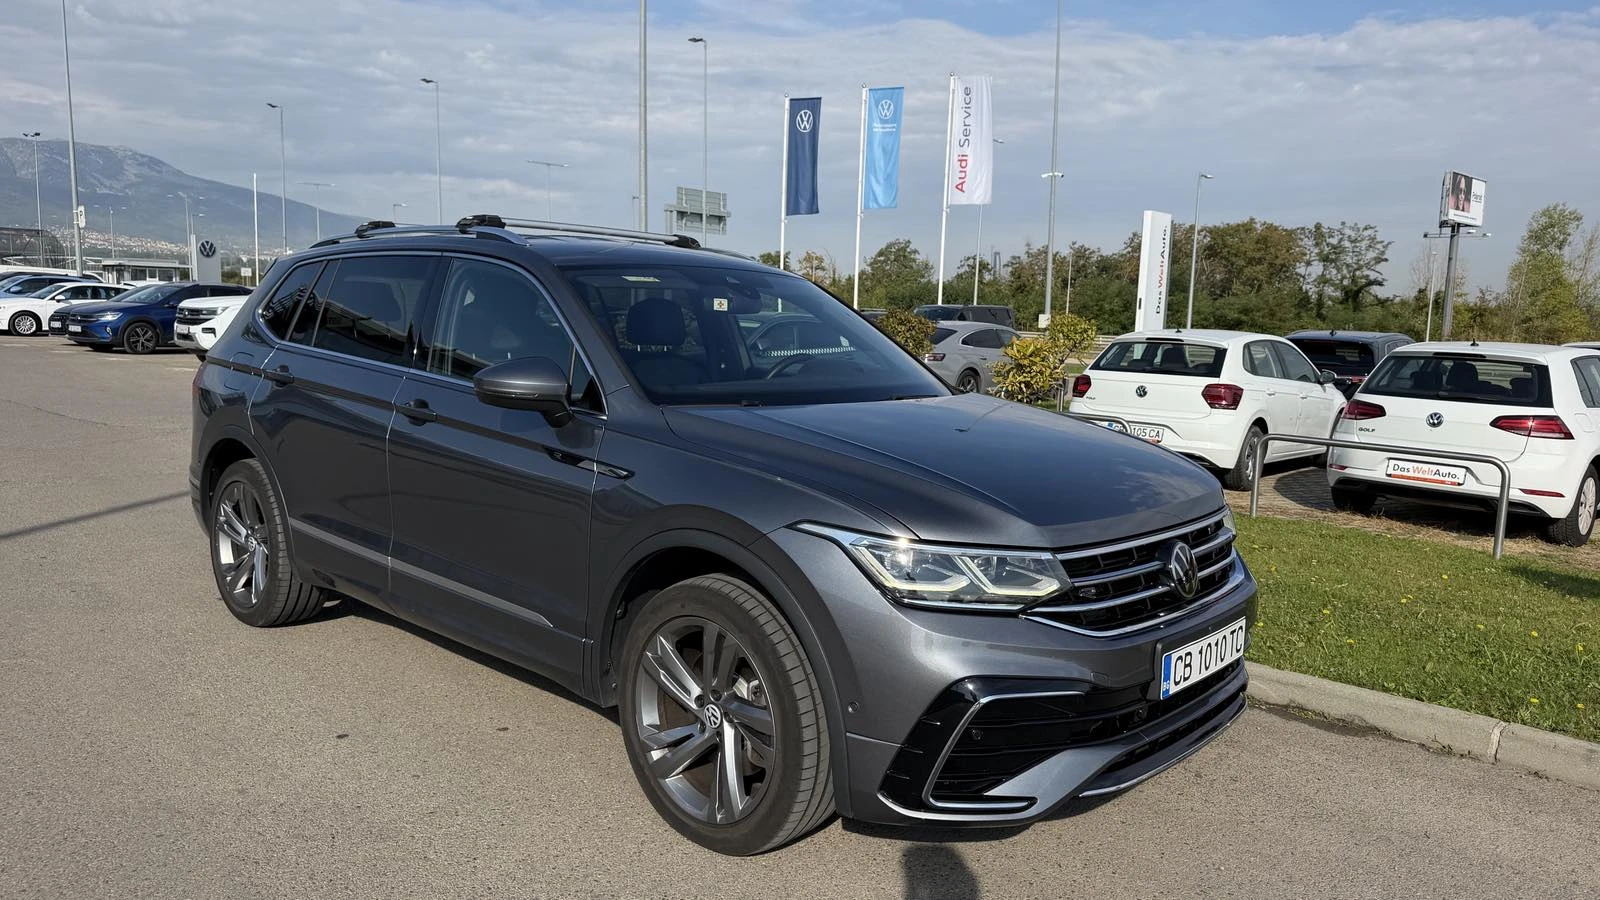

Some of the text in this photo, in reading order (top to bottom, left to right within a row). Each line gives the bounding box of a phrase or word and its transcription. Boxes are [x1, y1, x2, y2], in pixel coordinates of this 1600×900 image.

[955, 86, 972, 193] Audi Service
[1148, 428, 1160, 439] CA
[1393, 463, 1460, 479] Das WeltAuto.
[1173, 625, 1243, 686] CB 1010 TC
